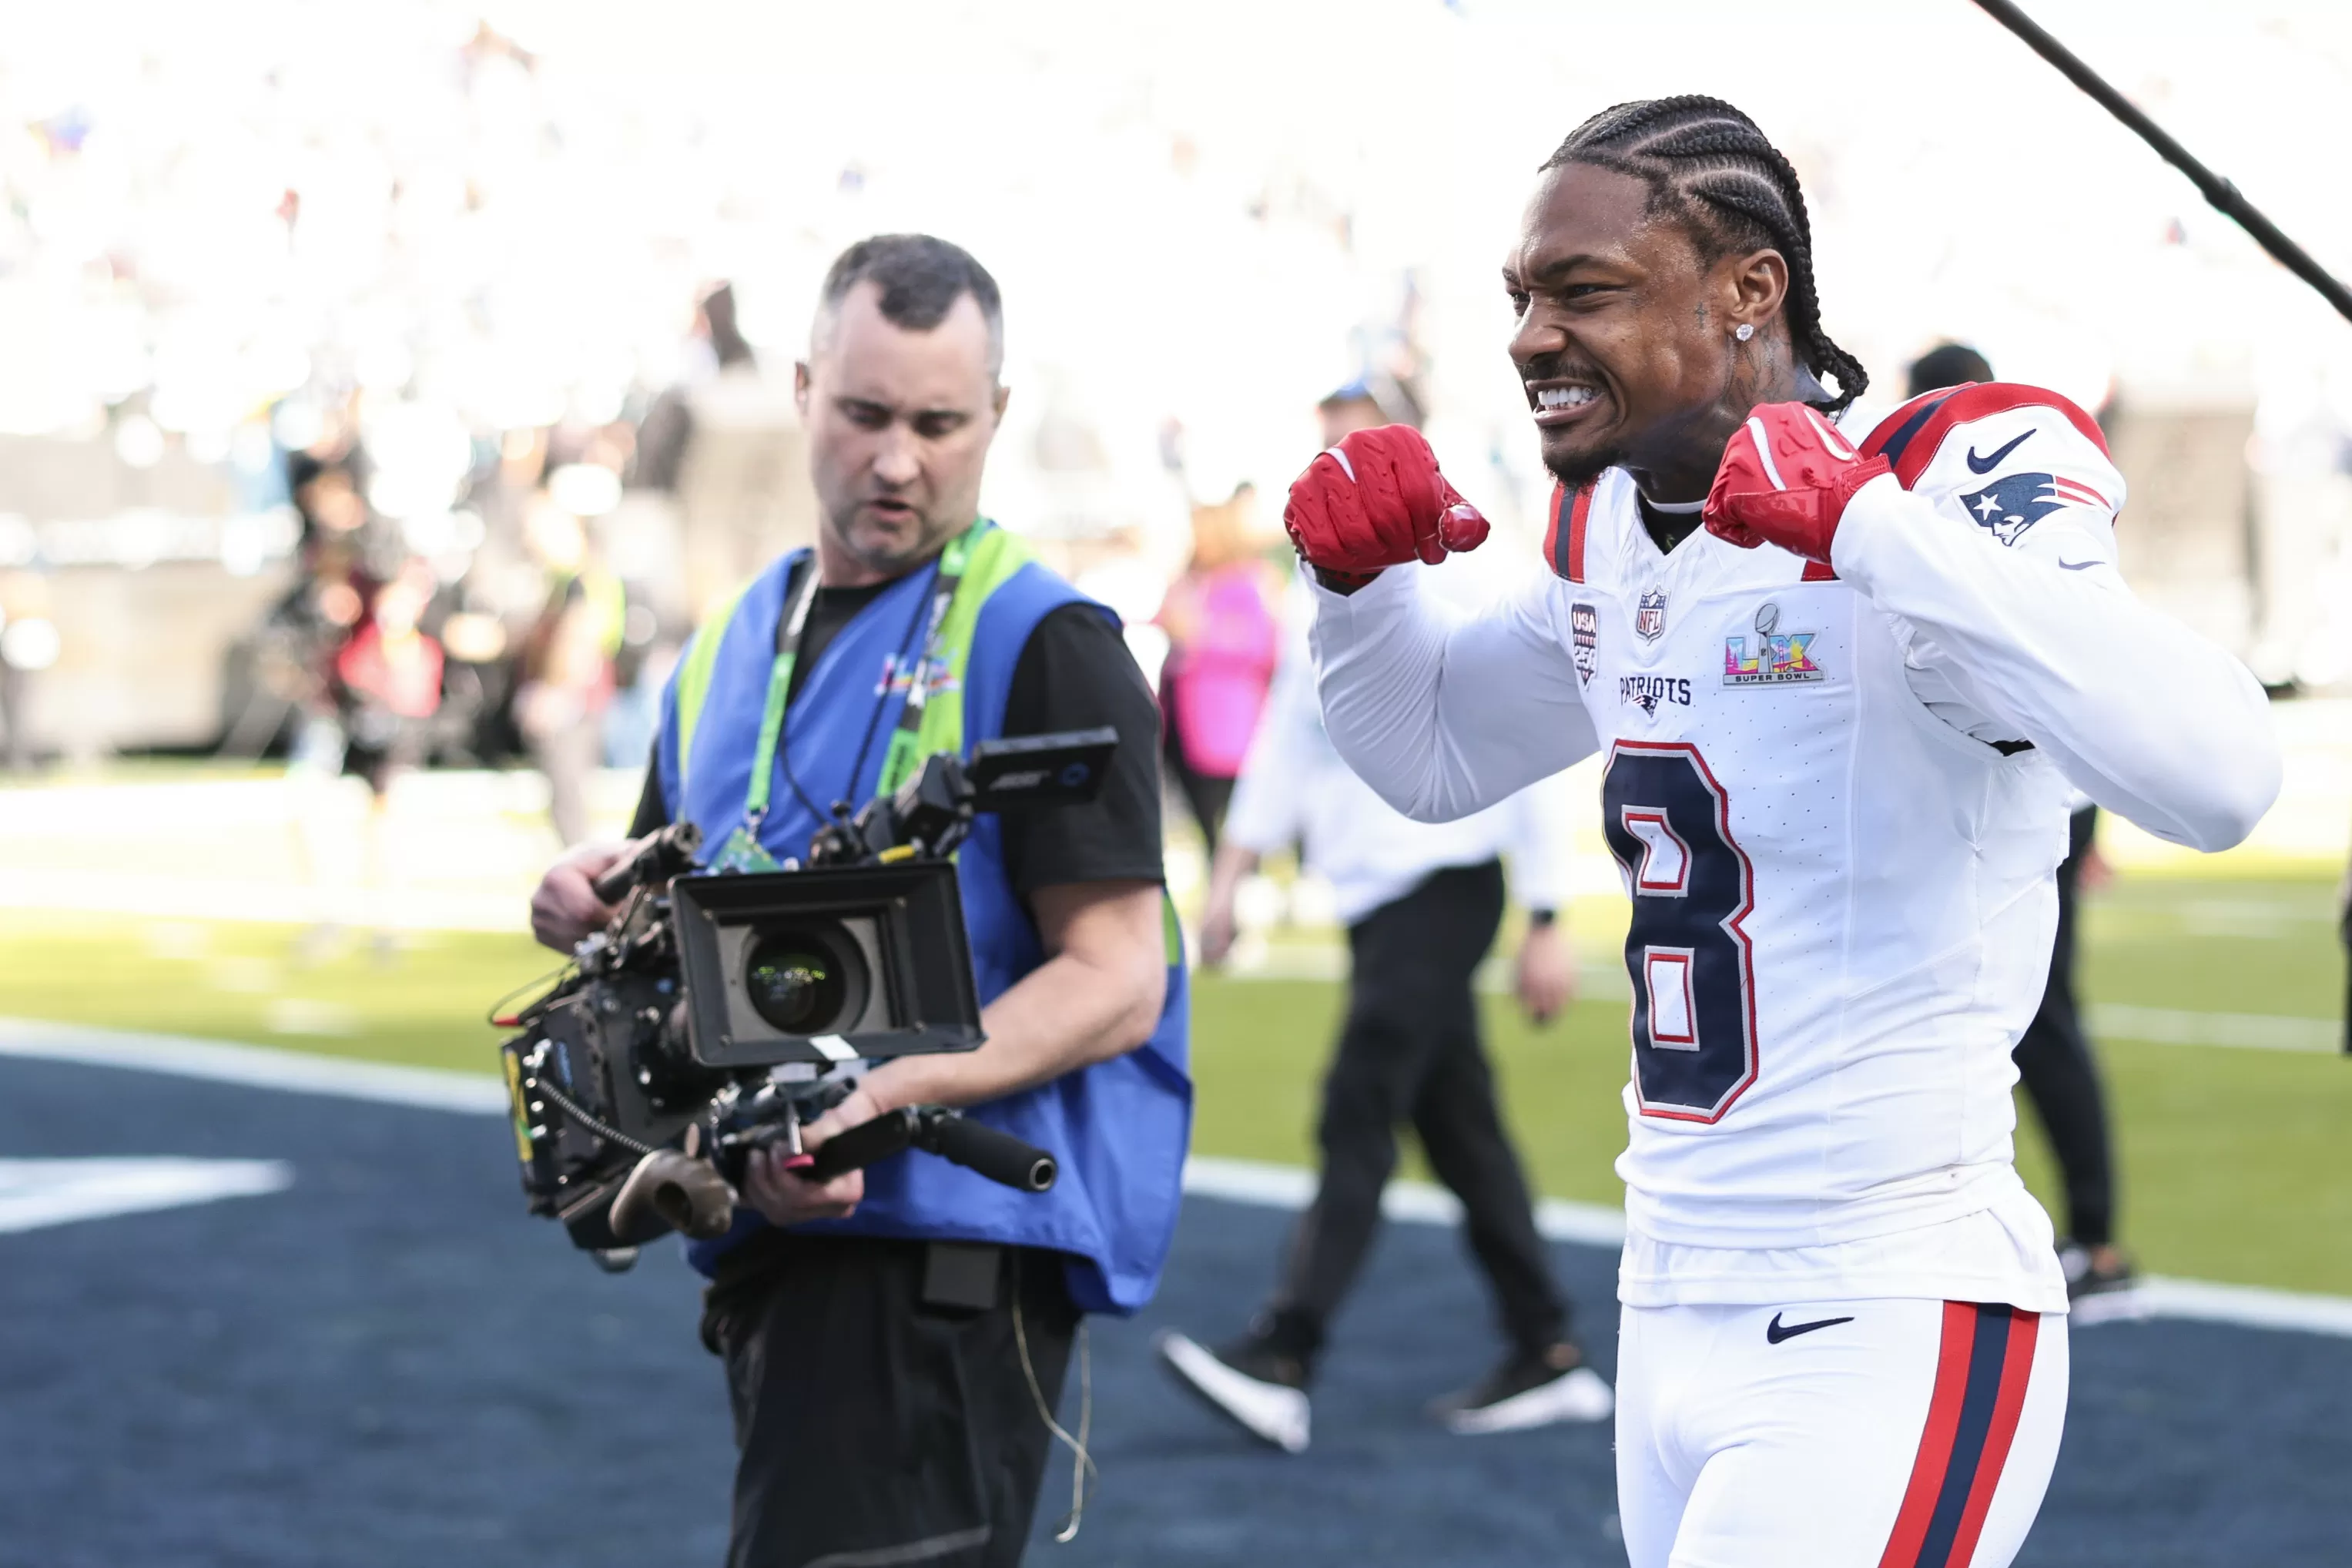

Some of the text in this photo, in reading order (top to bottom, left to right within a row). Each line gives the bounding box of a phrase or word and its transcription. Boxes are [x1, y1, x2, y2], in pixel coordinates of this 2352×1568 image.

[1573, 611, 1596, 633] USA
[1639, 610, 1660, 632] NFL
[1735, 672, 1810, 682] SUPER BOWL
[1620, 676, 1690, 706] PATRIOTS
[1600, 739, 1758, 1125] 8
